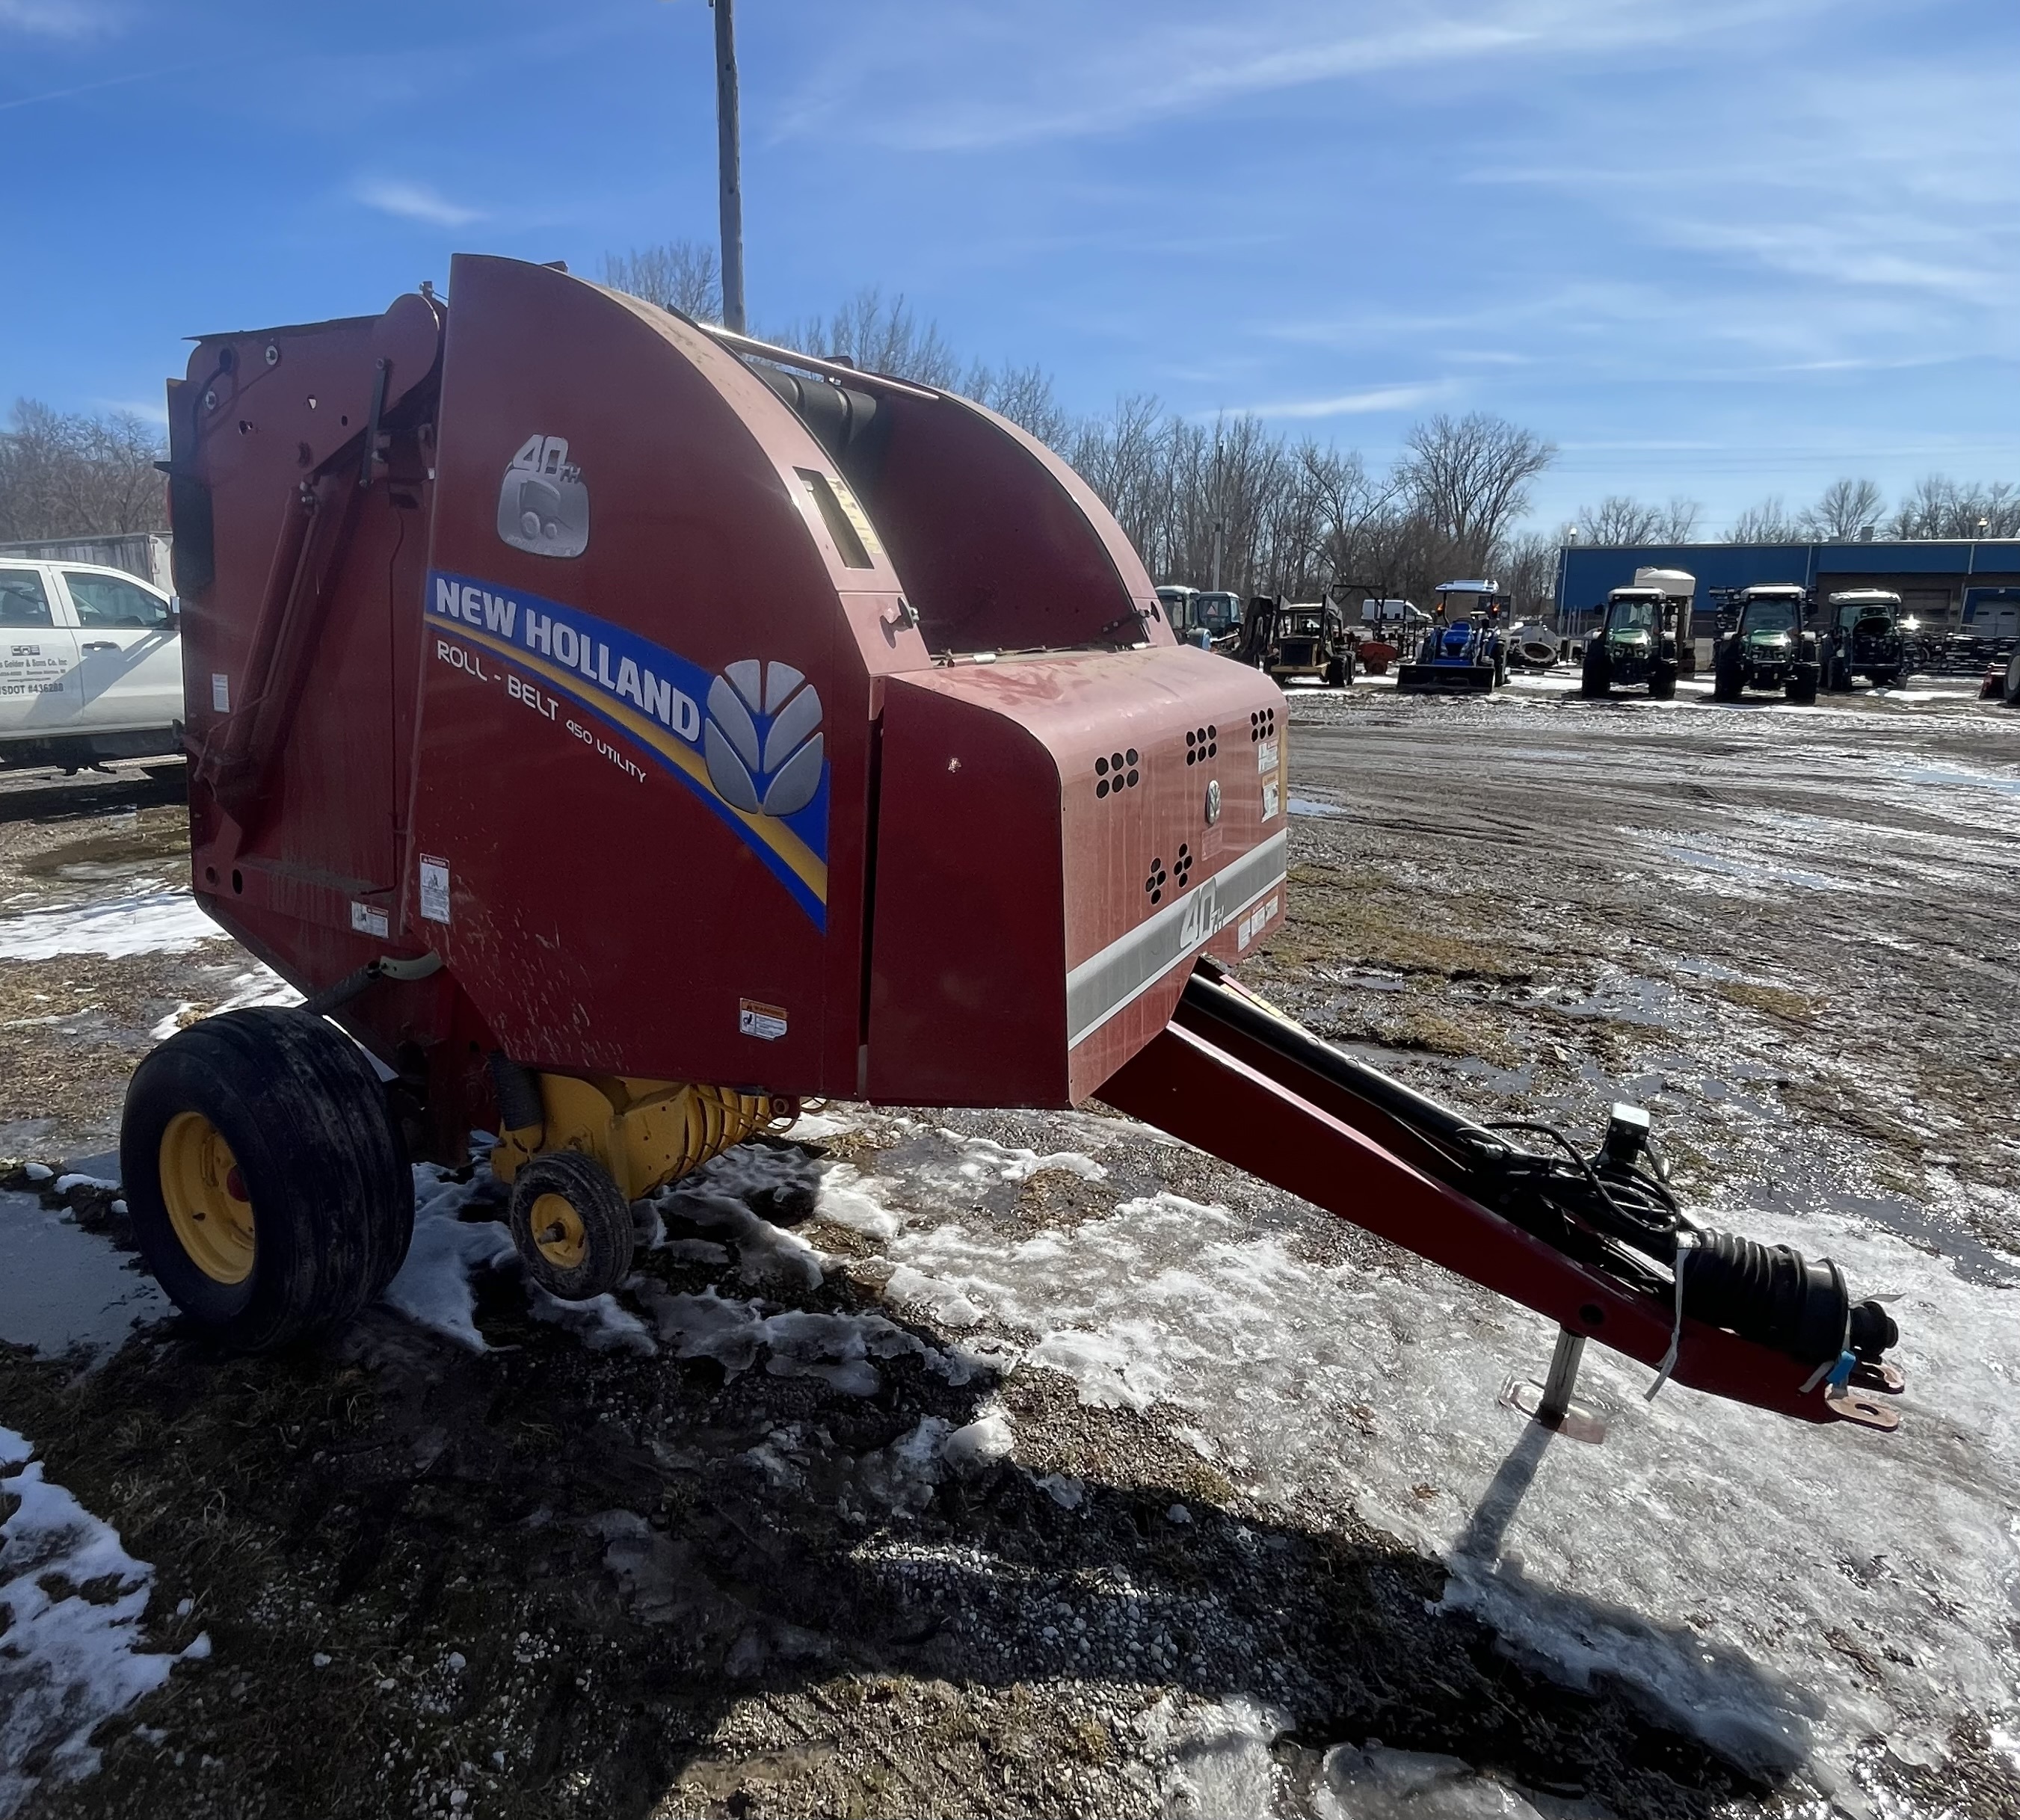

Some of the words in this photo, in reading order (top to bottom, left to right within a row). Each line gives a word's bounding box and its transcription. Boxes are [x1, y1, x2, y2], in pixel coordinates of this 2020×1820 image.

[0, 685, 25, 695] SDOT
[437, 578, 517, 638] NEW
[526, 608, 700, 741] HOLLAND
[437, 640, 487, 681] ROLL
[508, 674, 559, 721] BELT
[566, 719, 593, 744] 450
[597, 738, 647, 783] UTILITY
